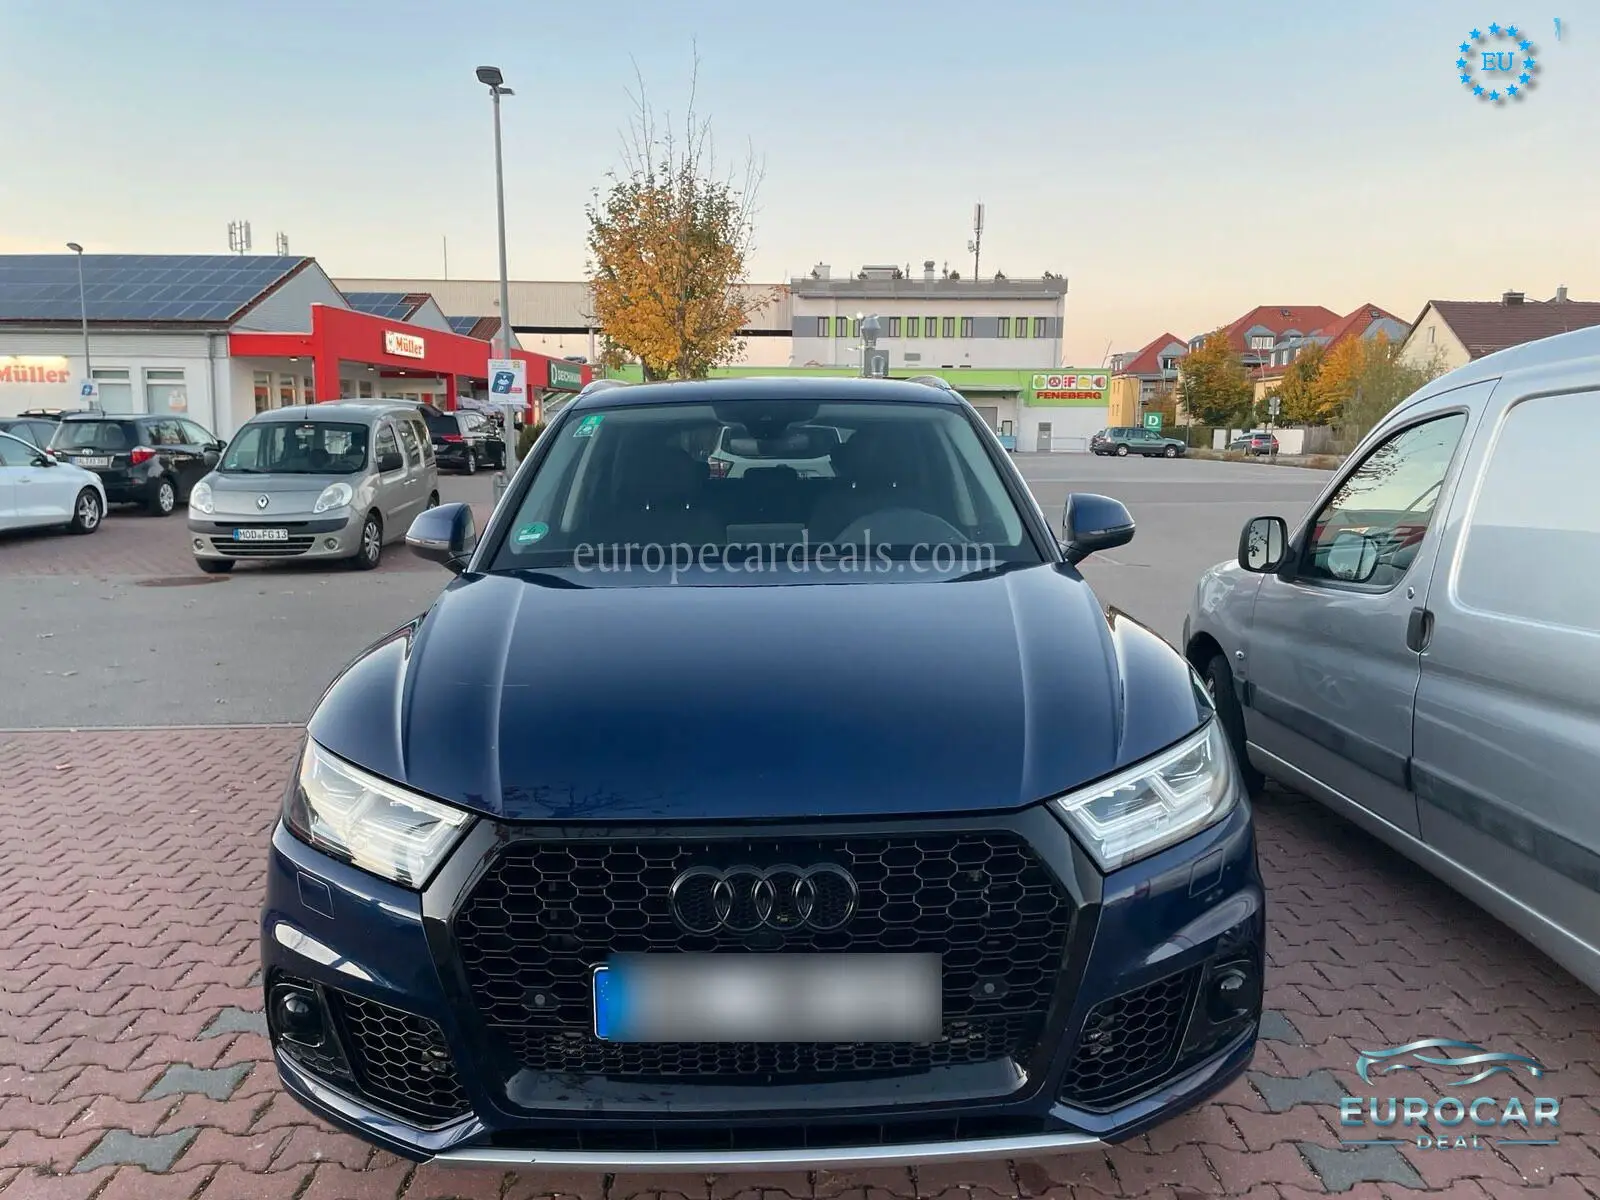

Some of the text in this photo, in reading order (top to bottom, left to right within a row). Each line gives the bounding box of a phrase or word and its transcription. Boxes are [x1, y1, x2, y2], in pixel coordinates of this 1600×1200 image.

[396, 335, 422, 355] Müller
[0, 365, 70, 383] Müller
[1036, 391, 1102, 399] FENEBERG
